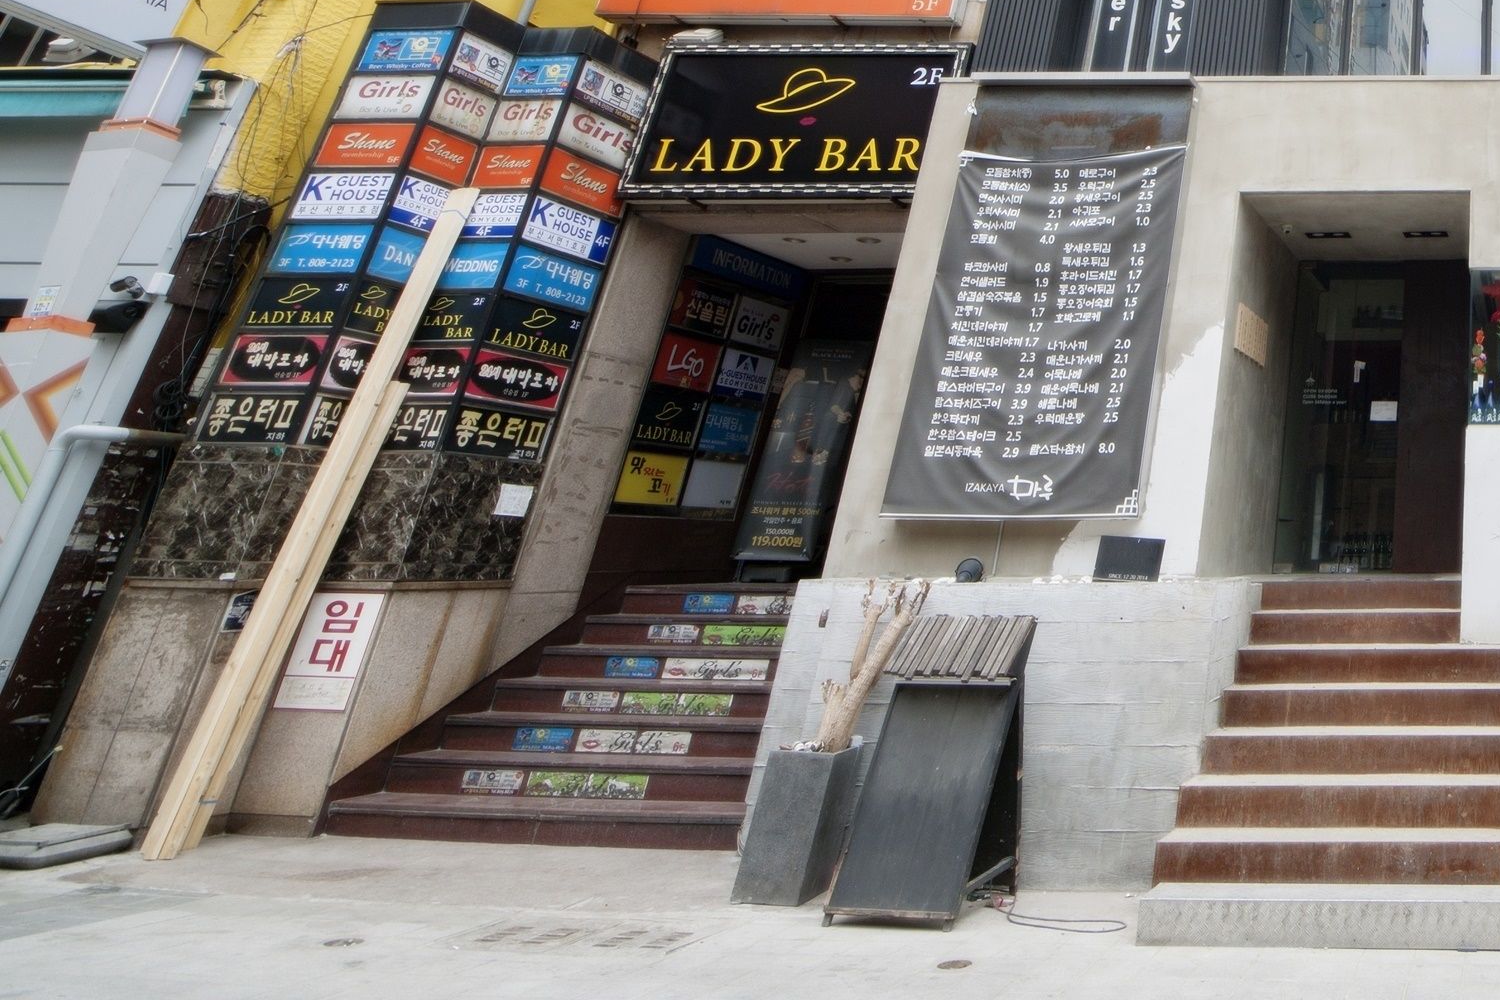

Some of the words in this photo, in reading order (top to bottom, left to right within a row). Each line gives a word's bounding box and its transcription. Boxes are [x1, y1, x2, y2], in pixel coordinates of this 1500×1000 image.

[910, 67, 944, 86] 2F
[359, 79, 421, 99] Girl's
[337, 132, 397, 149] Shane
[424, 139, 465, 164] Shane
[650, 138, 801, 172] LADY
[815, 138, 920, 171] BAR
[486, 155, 531, 169] Shane
[1054, 169, 1069, 179] 5.0
[1143, 168, 1158, 176] 2.3
[336, 176, 391, 187] GUEST
[561, 162, 608, 194] Shane
[1053, 184, 1068, 192] 3.5
[1141, 180, 1156, 188] 2.5
[331, 190, 388, 201] HOUSE
[486, 195, 525, 203] GUEST
[1049, 196, 1064, 205] 2.0
[1138, 191, 1153, 200] 2.5
[482, 205, 522, 213] HOUSE
[1136, 204, 1151, 213] 2.3
[558, 207, 595, 228] GUEST
[1048, 210, 1062, 219] 2.1
[410, 215, 427, 228] 4F
[1043, 223, 1059, 231] 2.1
[1136, 217, 1150, 226] 1.0
[476, 227, 493, 235] 4F
[552, 220, 592, 242] HOUSE
[312, 234, 366, 249] 다나웨딩
[595, 235, 610, 248] 4F
[1040, 236, 1055, 245] 4.0
[1132, 243, 1146, 252] 1.3
[278, 259, 291, 267] 3F
[1130, 257, 1144, 266] 1.6
[712, 248, 792, 288] INFORMATION
[547, 261, 594, 289] 다나웨딩
[335, 283, 349, 292] 2F
[517, 278, 529, 288] 3F
[473, 298, 485, 306] 2F
[248, 311, 297, 324] LADY
[299, 311, 335, 323] BAR
[686, 300, 729, 326] 산울림
[424, 315, 463, 326] LADY
[570, 319, 581, 329] 2F
[446, 327, 473, 338] BAR
[737, 315, 775, 341] Girl's
[491, 328, 539, 348] LADY
[538, 341, 569, 358] BAR
[503, 366, 559, 392] 대박포차
[266, 432, 285, 441] 지하
[636, 424, 669, 440] LADY
[671, 430, 692, 444] BAR
[419, 440, 435, 449] 지하
[965, 483, 1005, 493] IZAKAYA
[751, 535, 803, 548] 119,000원
